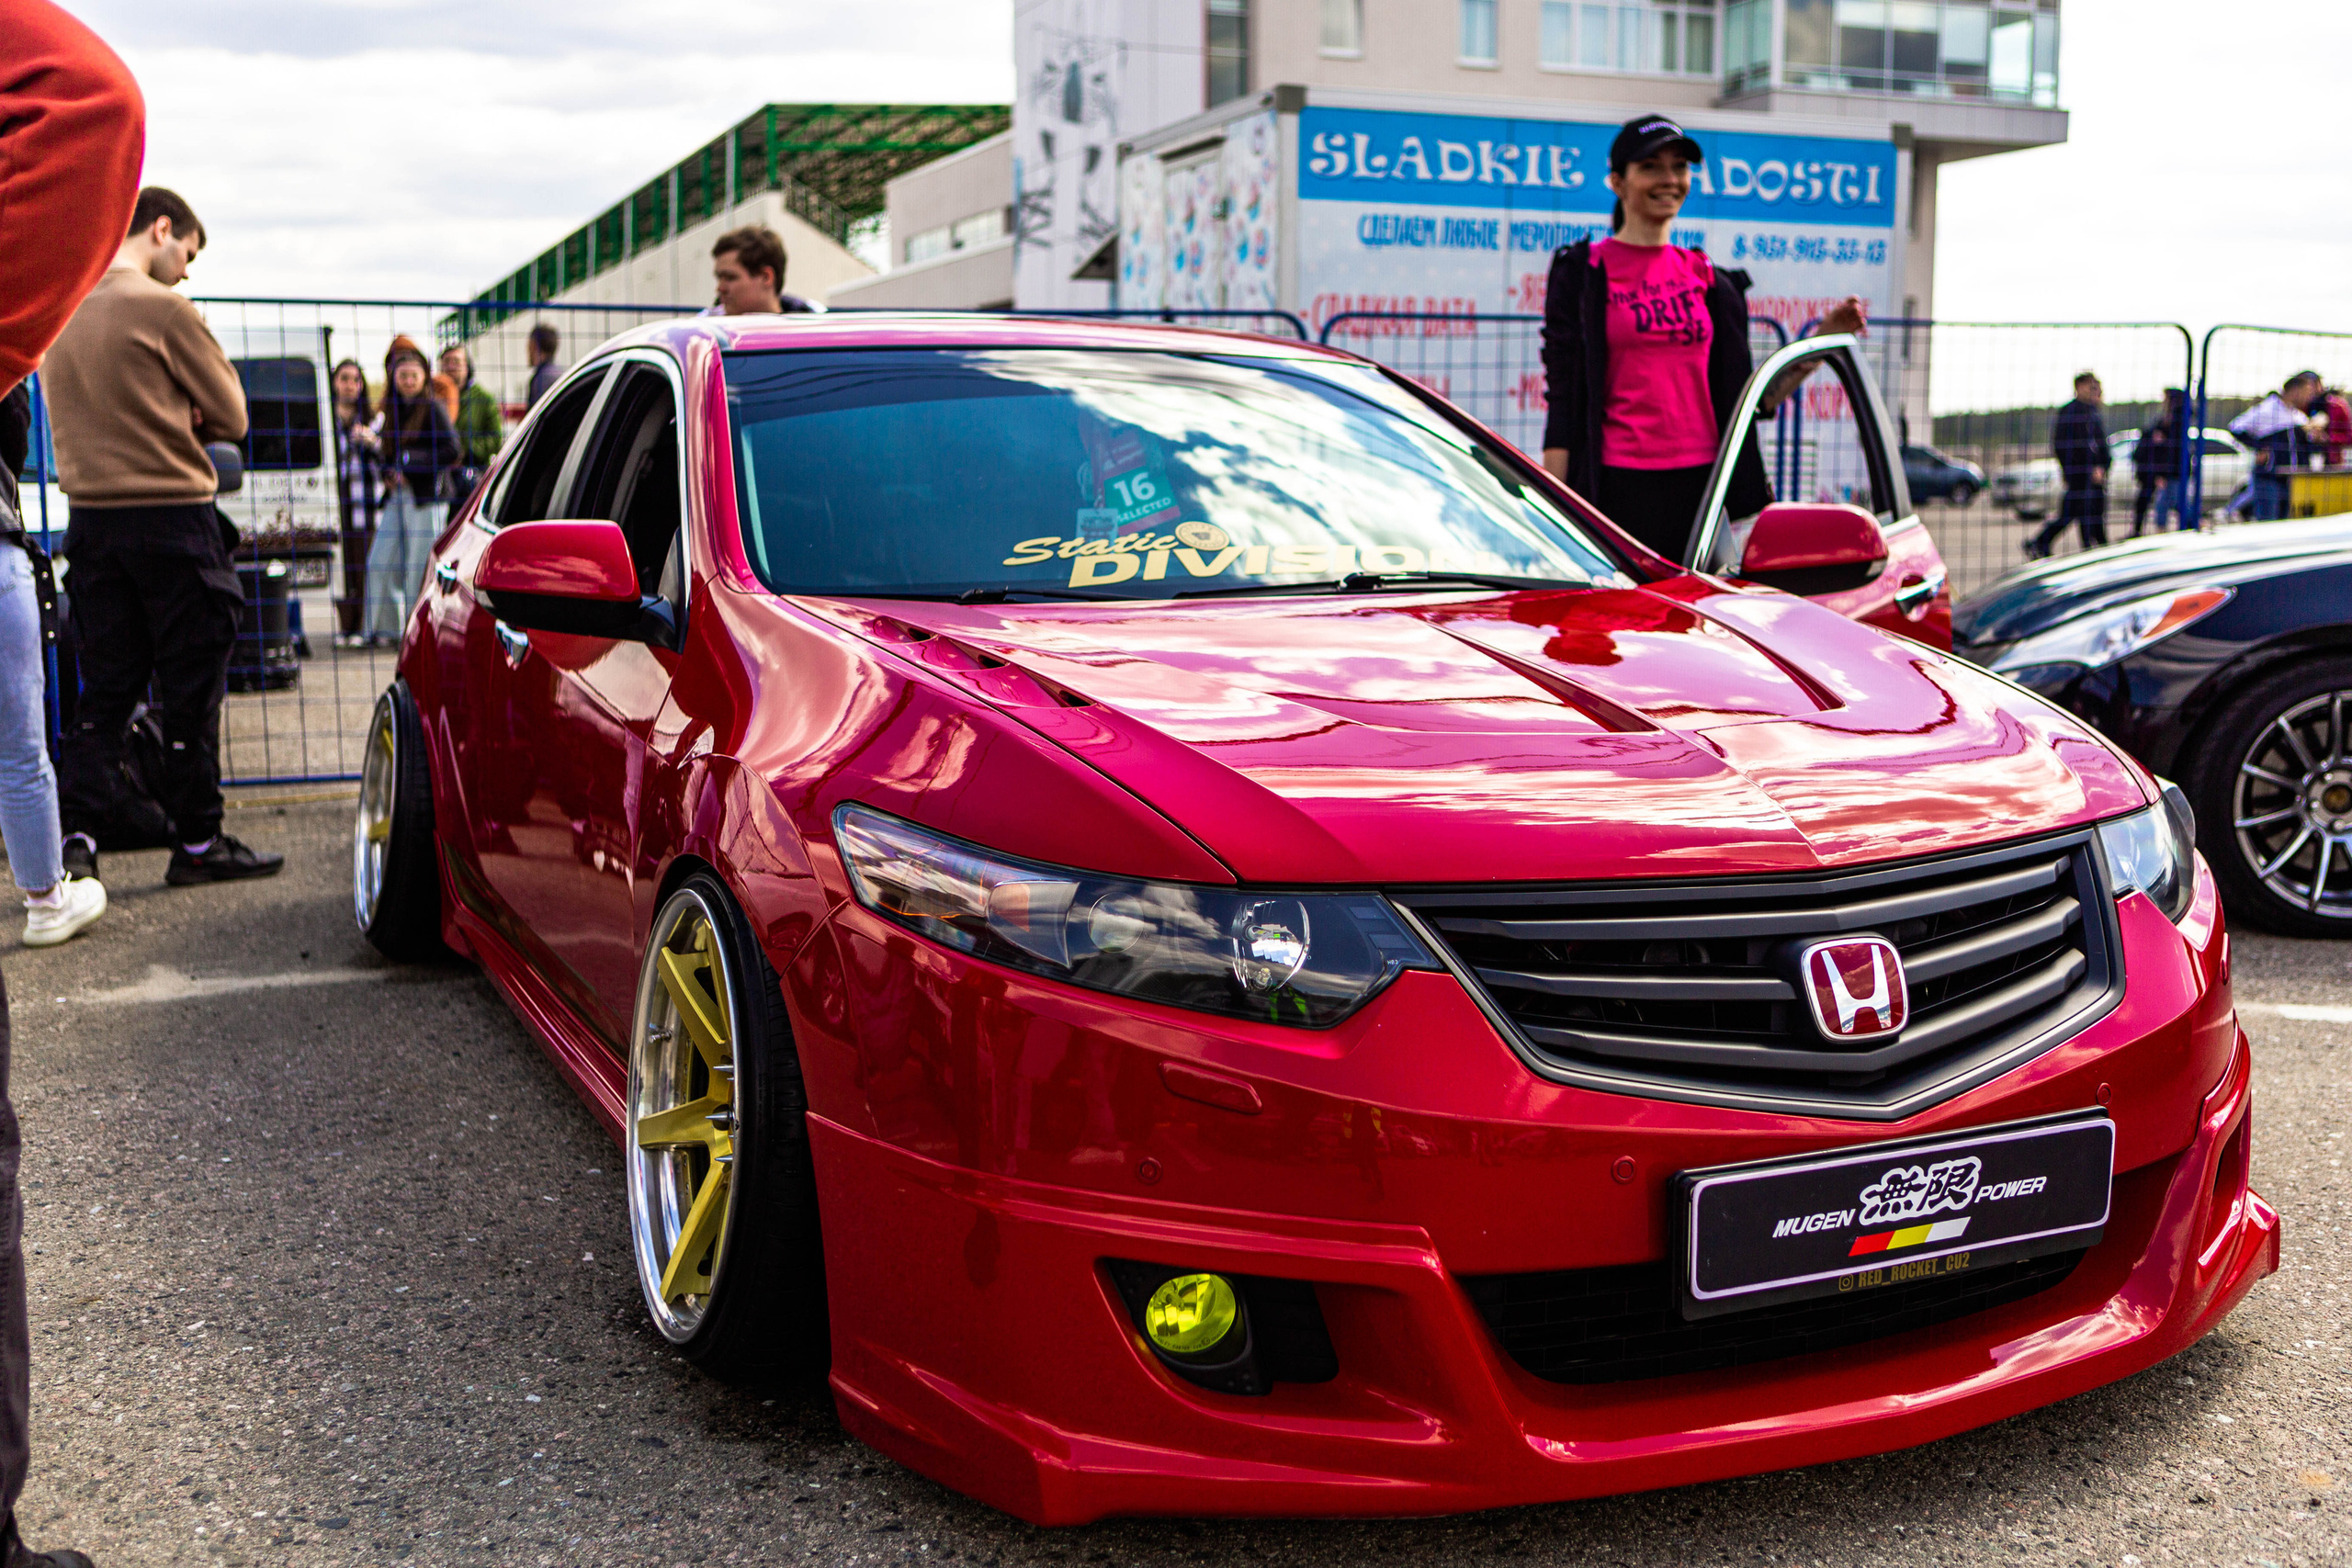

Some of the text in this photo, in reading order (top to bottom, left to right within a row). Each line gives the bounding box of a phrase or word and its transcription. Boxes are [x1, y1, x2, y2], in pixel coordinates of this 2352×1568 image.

[1308, 131, 1883, 206] SLADKIE ADOSTI
[1113, 471, 1156, 507] 16
[1002, 532, 1180, 566] Static
[1069, 544, 1491, 588] DIVISION
[1772, 1208, 1856, 1238] MUGEN
[1974, 1176, 2048, 1204] POWER
[1858, 1251, 1971, 1289] RED_ROCKET_CU2
